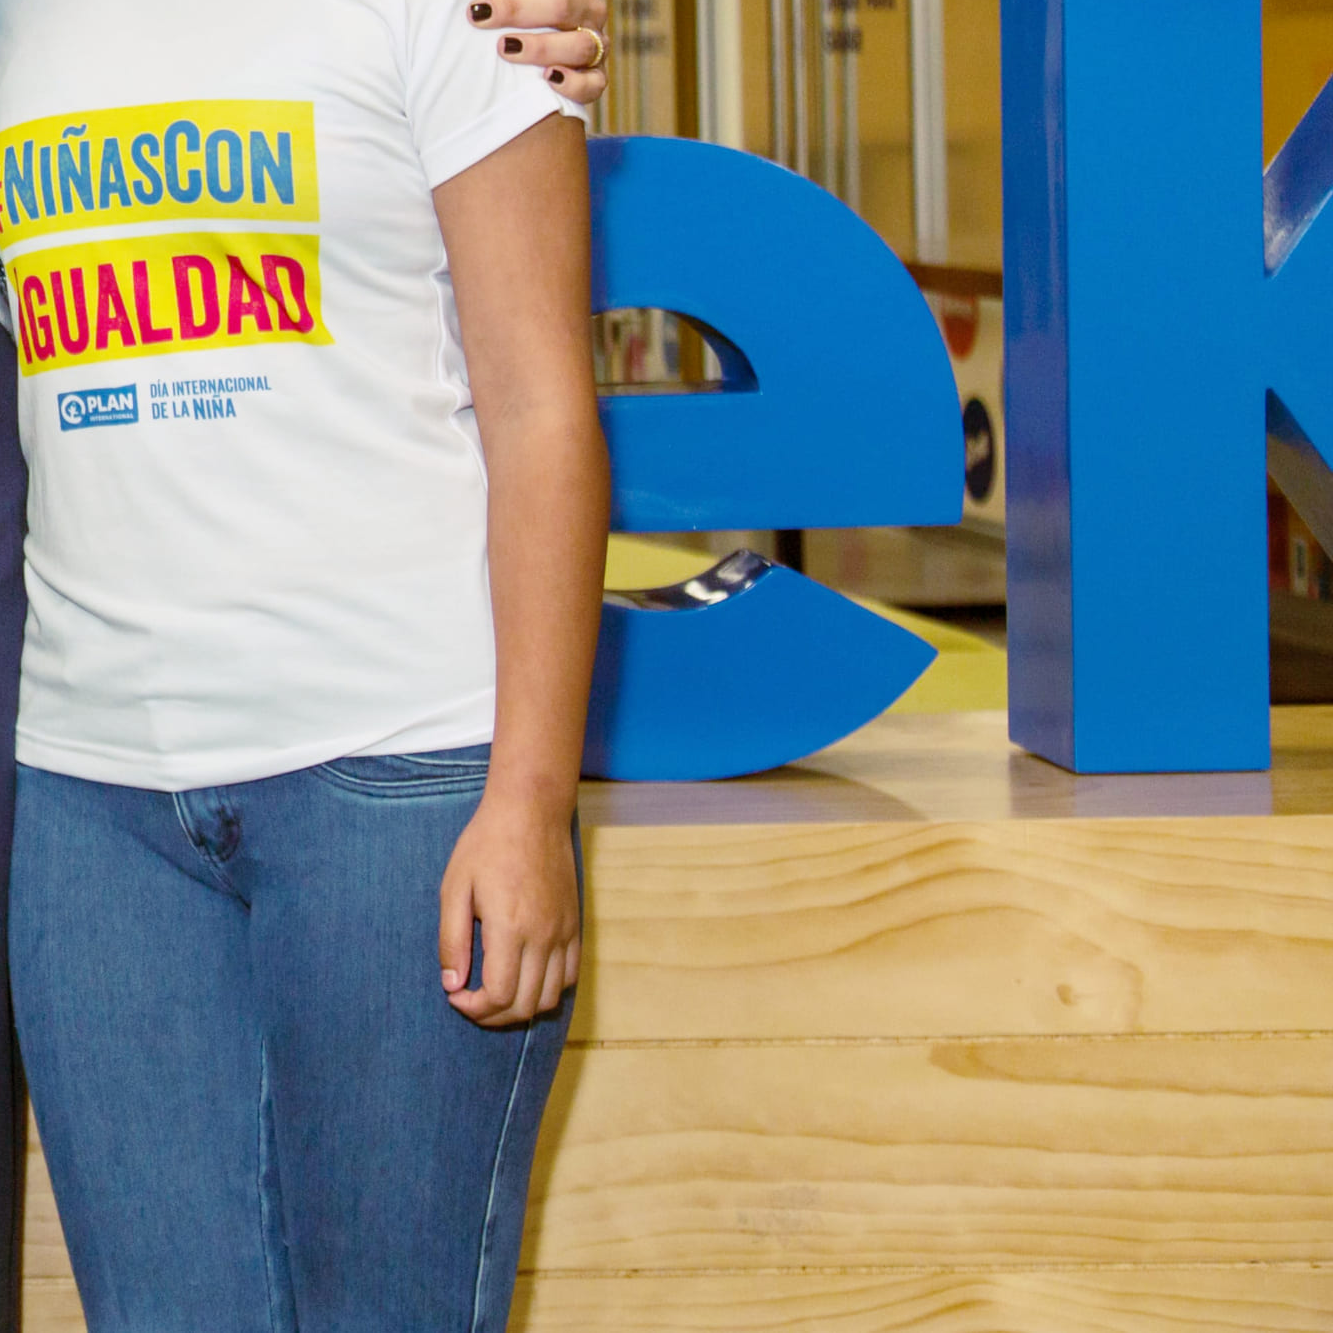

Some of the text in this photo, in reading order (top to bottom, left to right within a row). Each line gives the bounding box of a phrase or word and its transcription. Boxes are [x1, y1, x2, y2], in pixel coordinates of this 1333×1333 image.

[13, 254, 315, 365] IGUALDAD
[150, 376, 272, 398] DÍA INTERNACIONAL
[87, 392, 134, 414] PLAN
[151, 394, 237, 421] DE LA NIÑA
[89, 412, 135, 422] INTERNATIONAL
